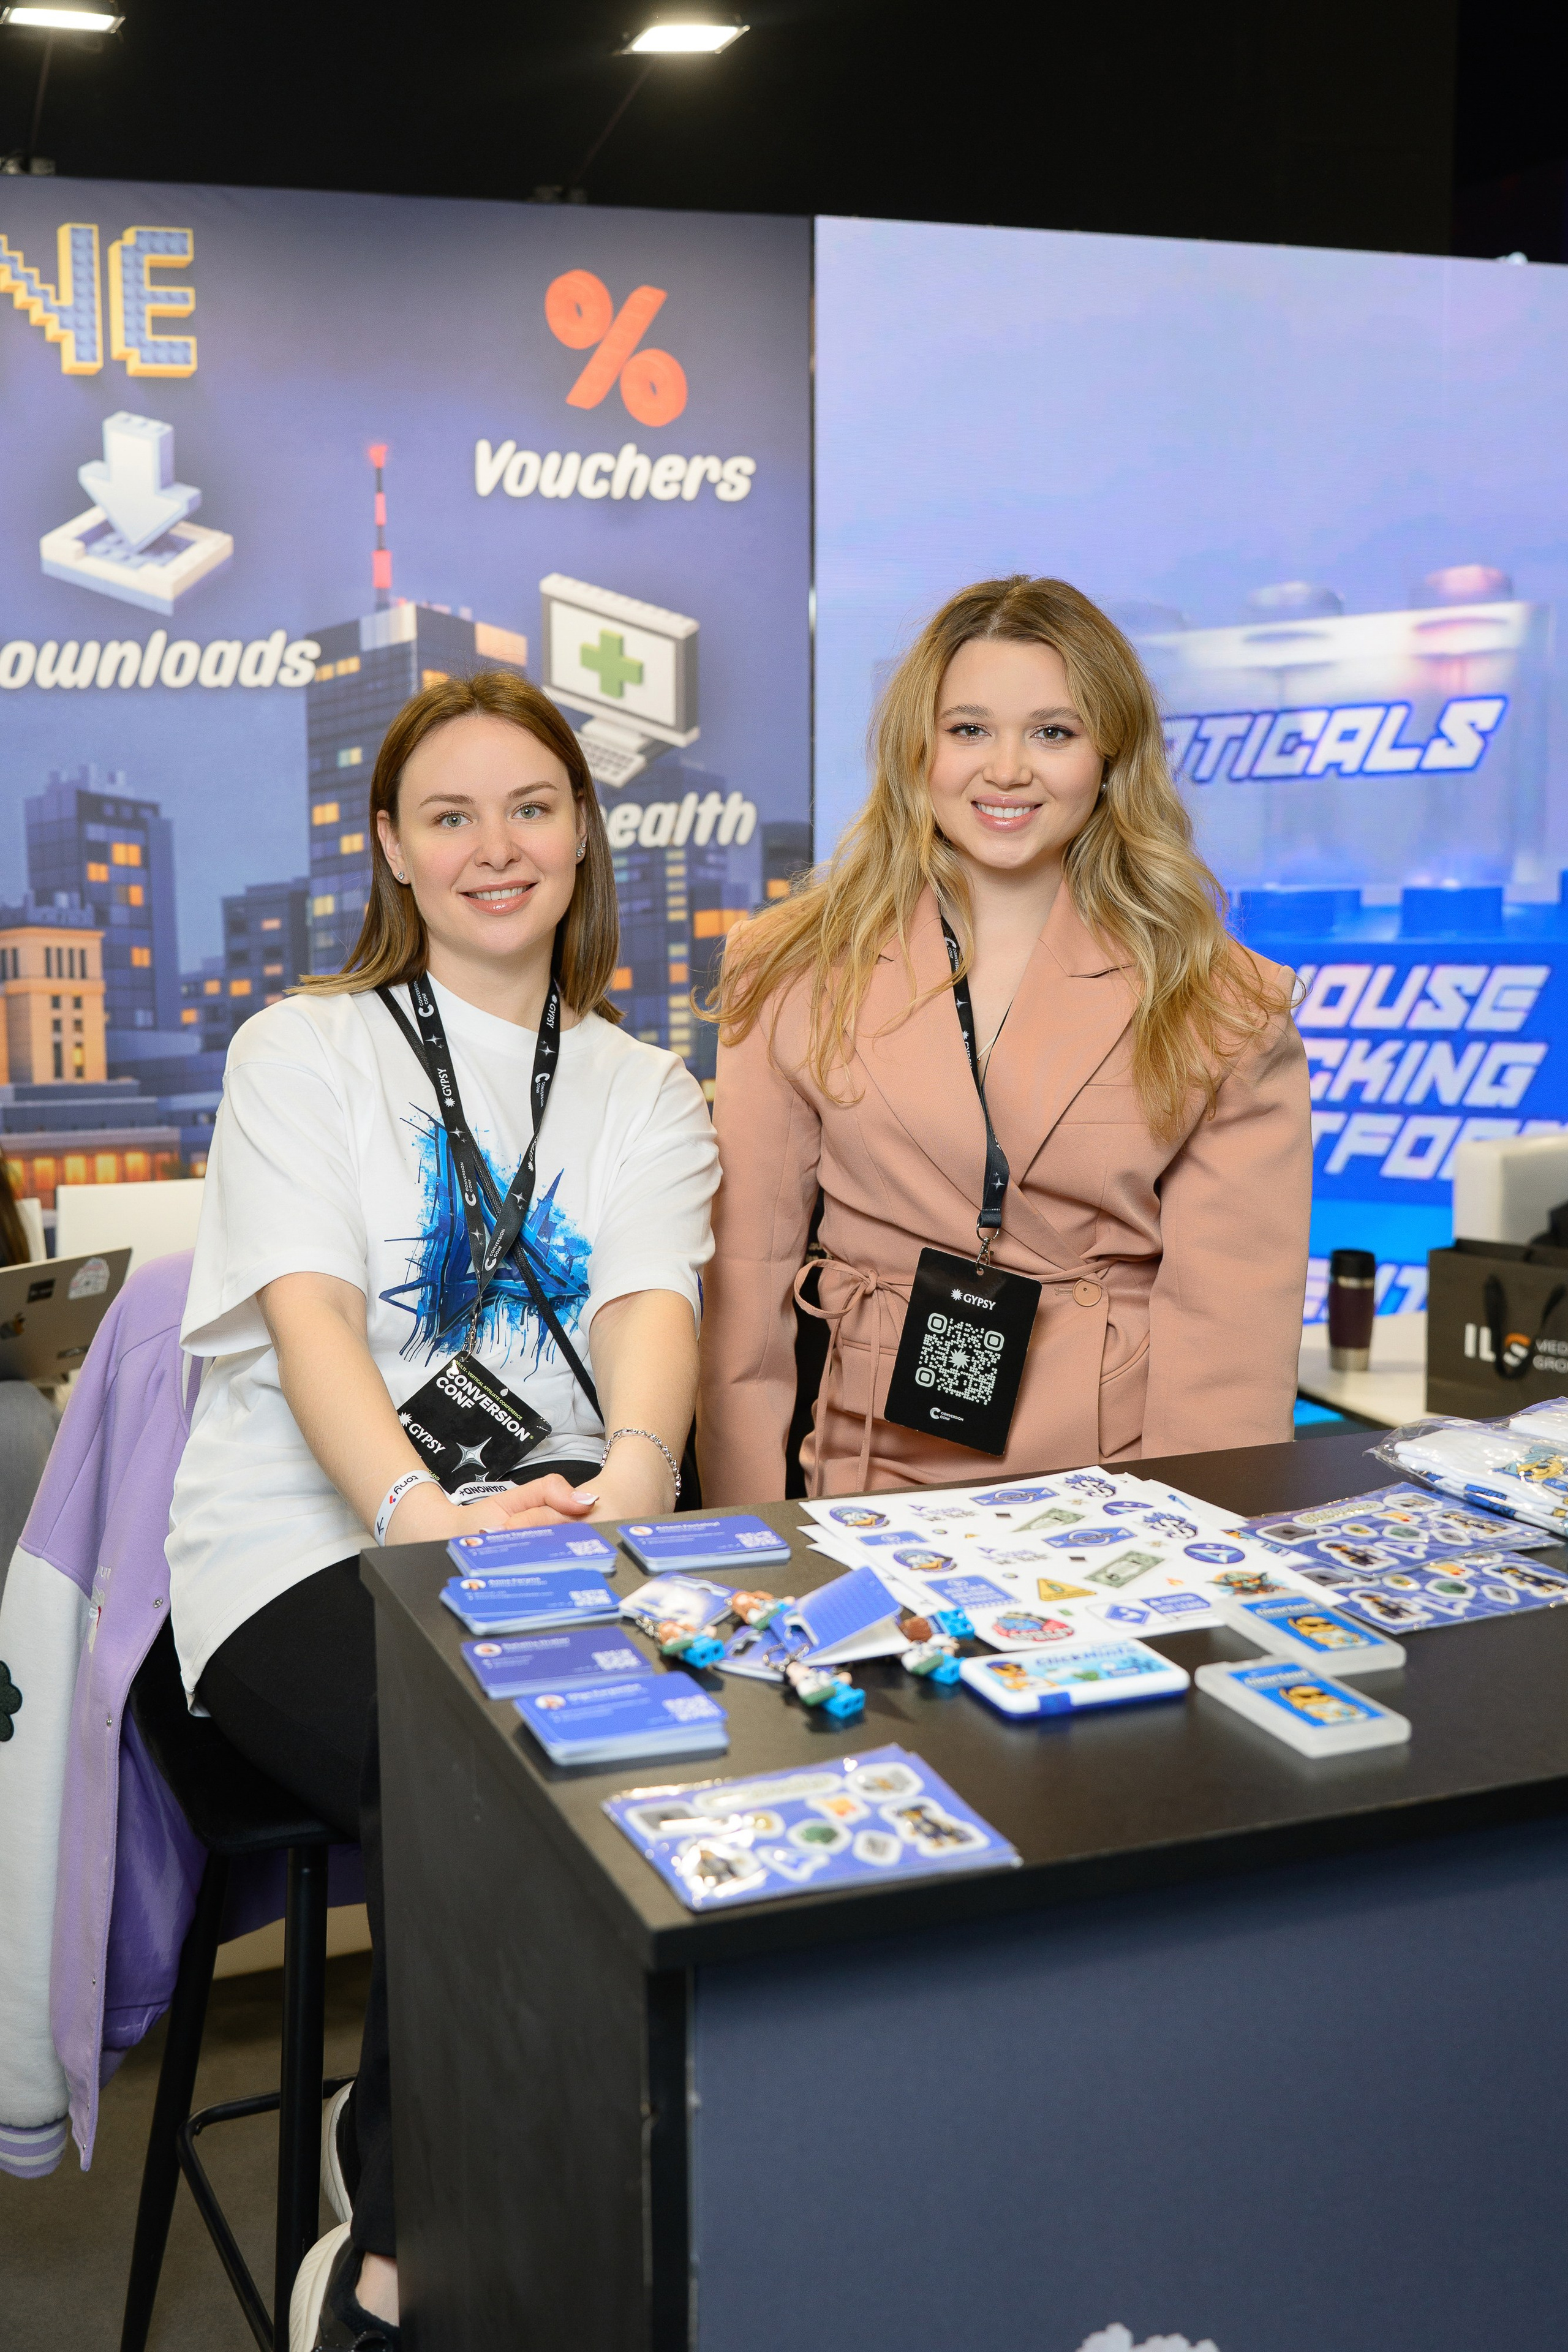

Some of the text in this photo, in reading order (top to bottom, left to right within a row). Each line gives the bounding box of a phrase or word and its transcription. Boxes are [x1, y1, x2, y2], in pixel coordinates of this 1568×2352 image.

[475, 439, 756, 502] Vouchers
[0, 630, 322, 690] ownloads
[600, 790, 756, 847] ealth
[547, 1003, 556, 1028] GYPSY
[437, 1068, 452, 1096] GYPSY
[460, 1162, 469, 1192] CONVERSION
[489, 1228, 505, 1256] CONVERSION
[494, 1246, 502, 1257] CONF
[963, 1294, 996, 1311] GYPSY
[435, 1376, 475, 1409] CONF
[467, 1371, 484, 1388] VERTICAL
[483, 1385, 500, 1401] AFFILIATE
[499, 1399, 522, 1420] CONFERENCE
[941, 1411, 964, 1422] CONVERSION
[409, 1423, 446, 1454] GYPSY
[394, 1474, 419, 1494] tony
[428, 1468, 440, 1481] OLAND
[459, 1485, 508, 1496] DIAMOND+
